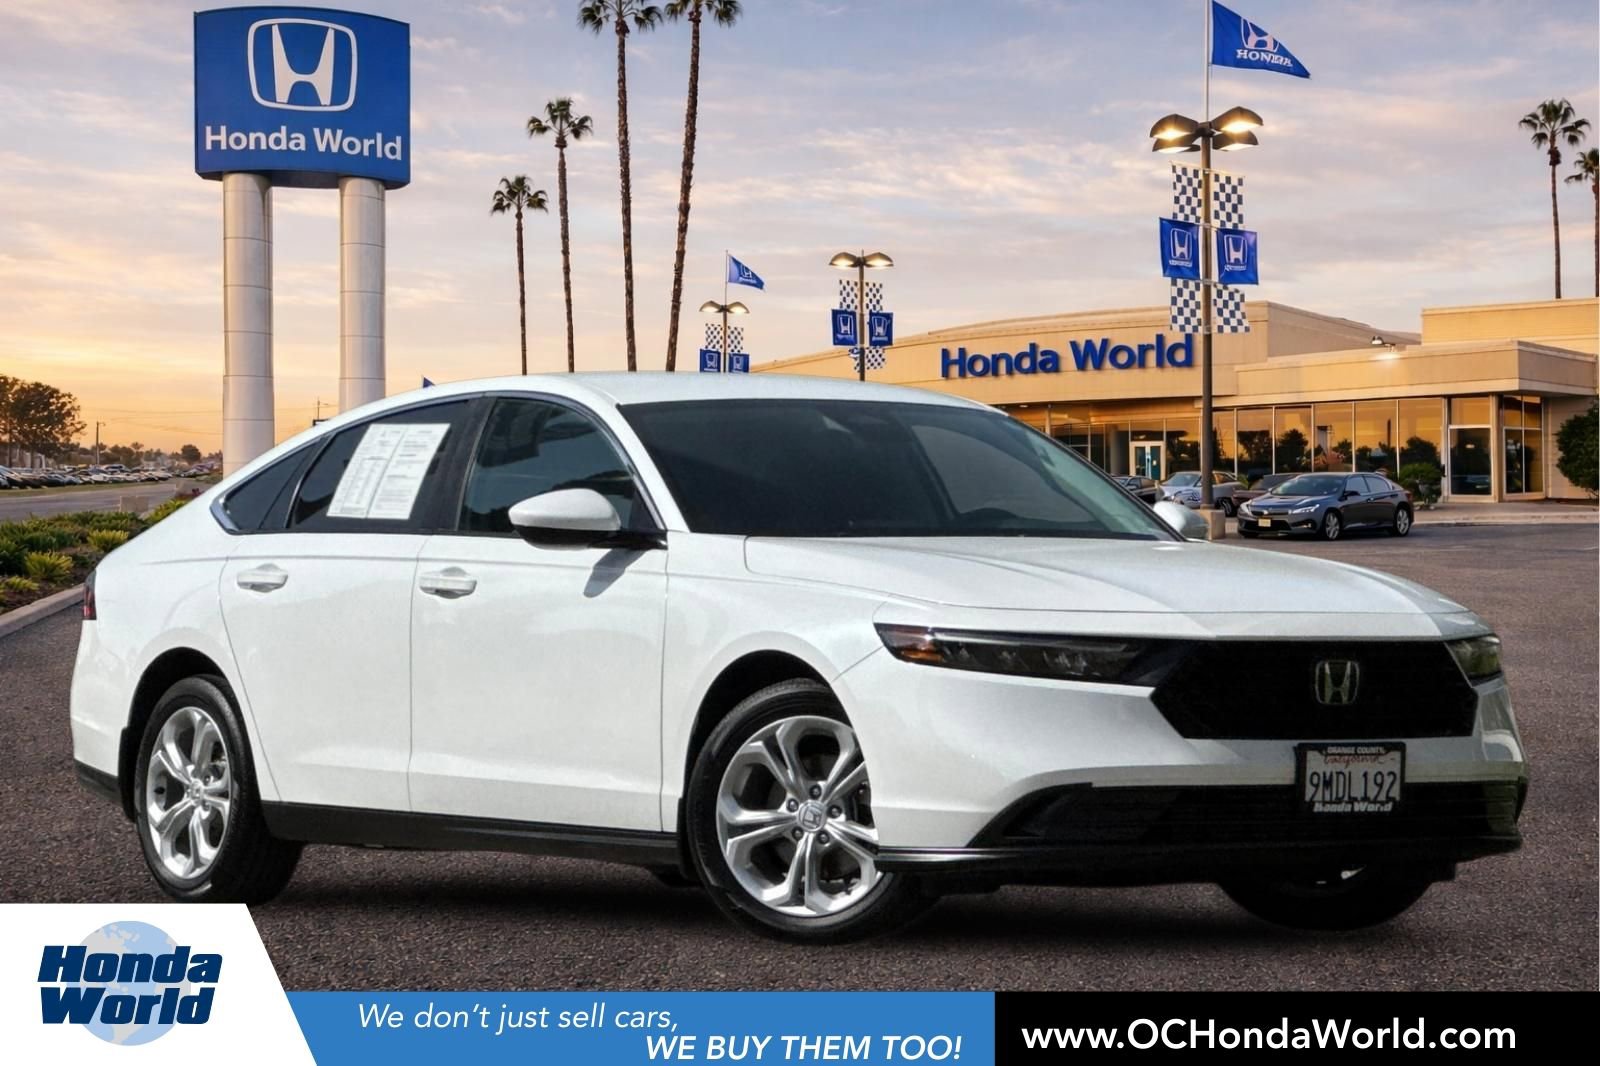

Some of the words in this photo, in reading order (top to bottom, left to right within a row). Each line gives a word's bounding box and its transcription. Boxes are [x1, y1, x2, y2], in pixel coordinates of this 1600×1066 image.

[205, 125, 306, 151] Honda
[313, 127, 402, 161] World
[941, 342, 1060, 378] Honda
[1069, 333, 1194, 371] World
[1309, 770, 1398, 801] 9MDL192
[1313, 801, 1353, 813] Honda
[1354, 801, 1393, 813] World
